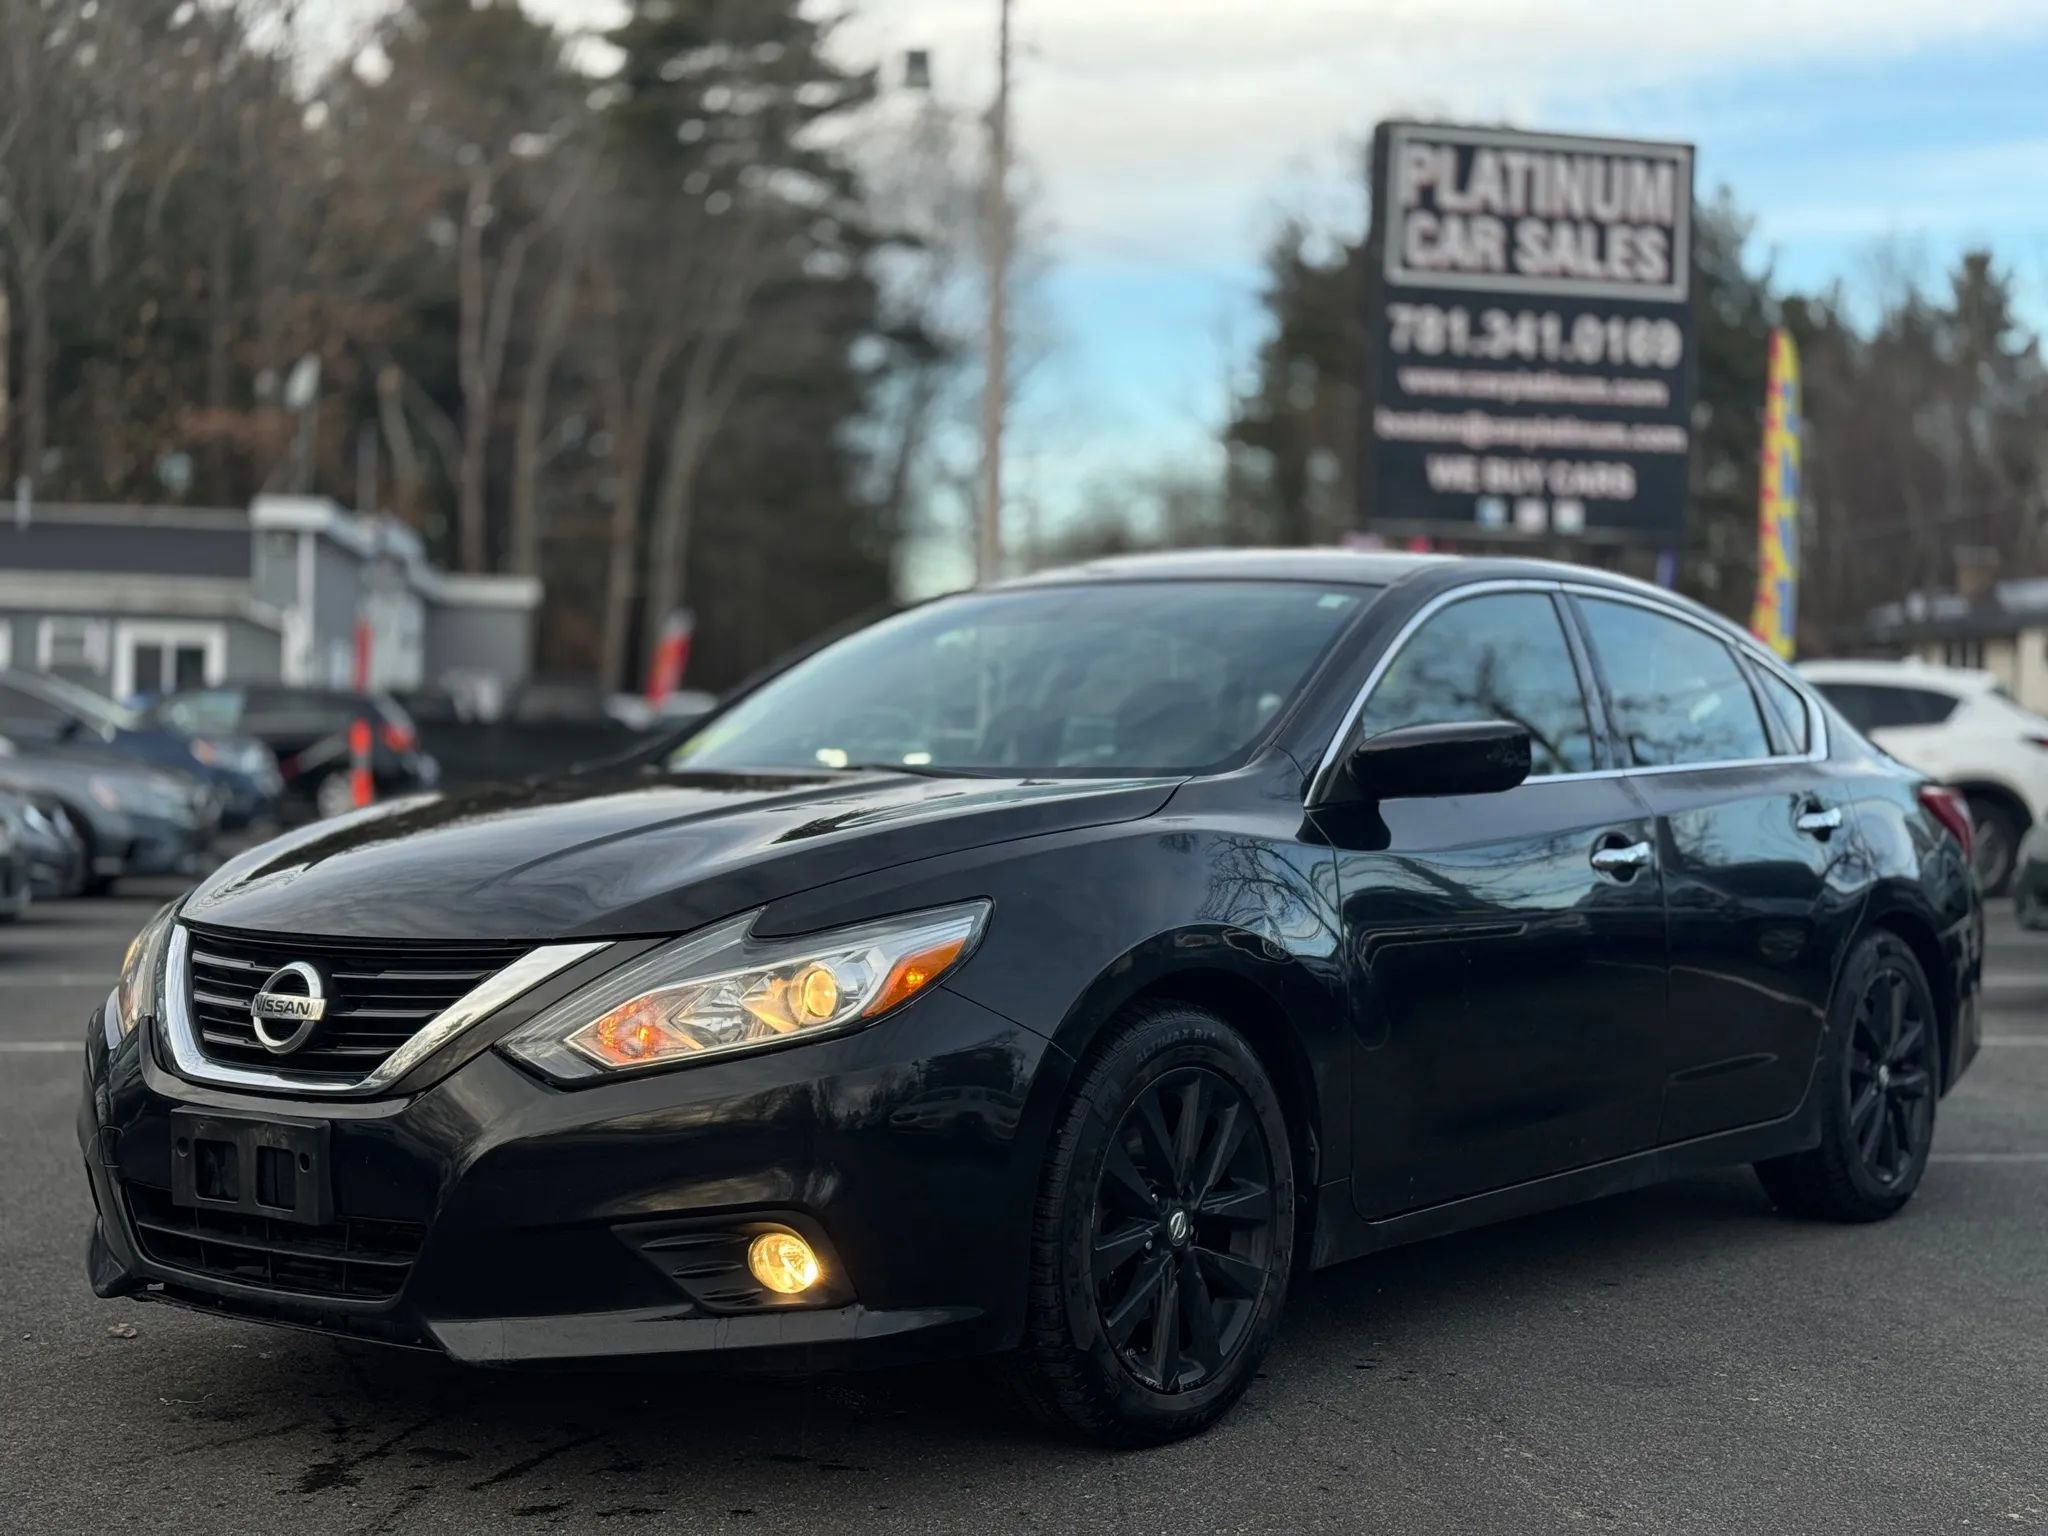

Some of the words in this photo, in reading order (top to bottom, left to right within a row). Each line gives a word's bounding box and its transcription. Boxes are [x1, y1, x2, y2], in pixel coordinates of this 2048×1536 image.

[1401, 144, 1674, 225] PLATINUM
[1404, 209, 1506, 272] CAR
[1514, 216, 1669, 282] SALES
[1427, 455, 1477, 493] WE
[1482, 456, 1547, 495] BUY
[1550, 459, 1636, 499] CARS
[253, 998, 311, 1016] NISSAN
